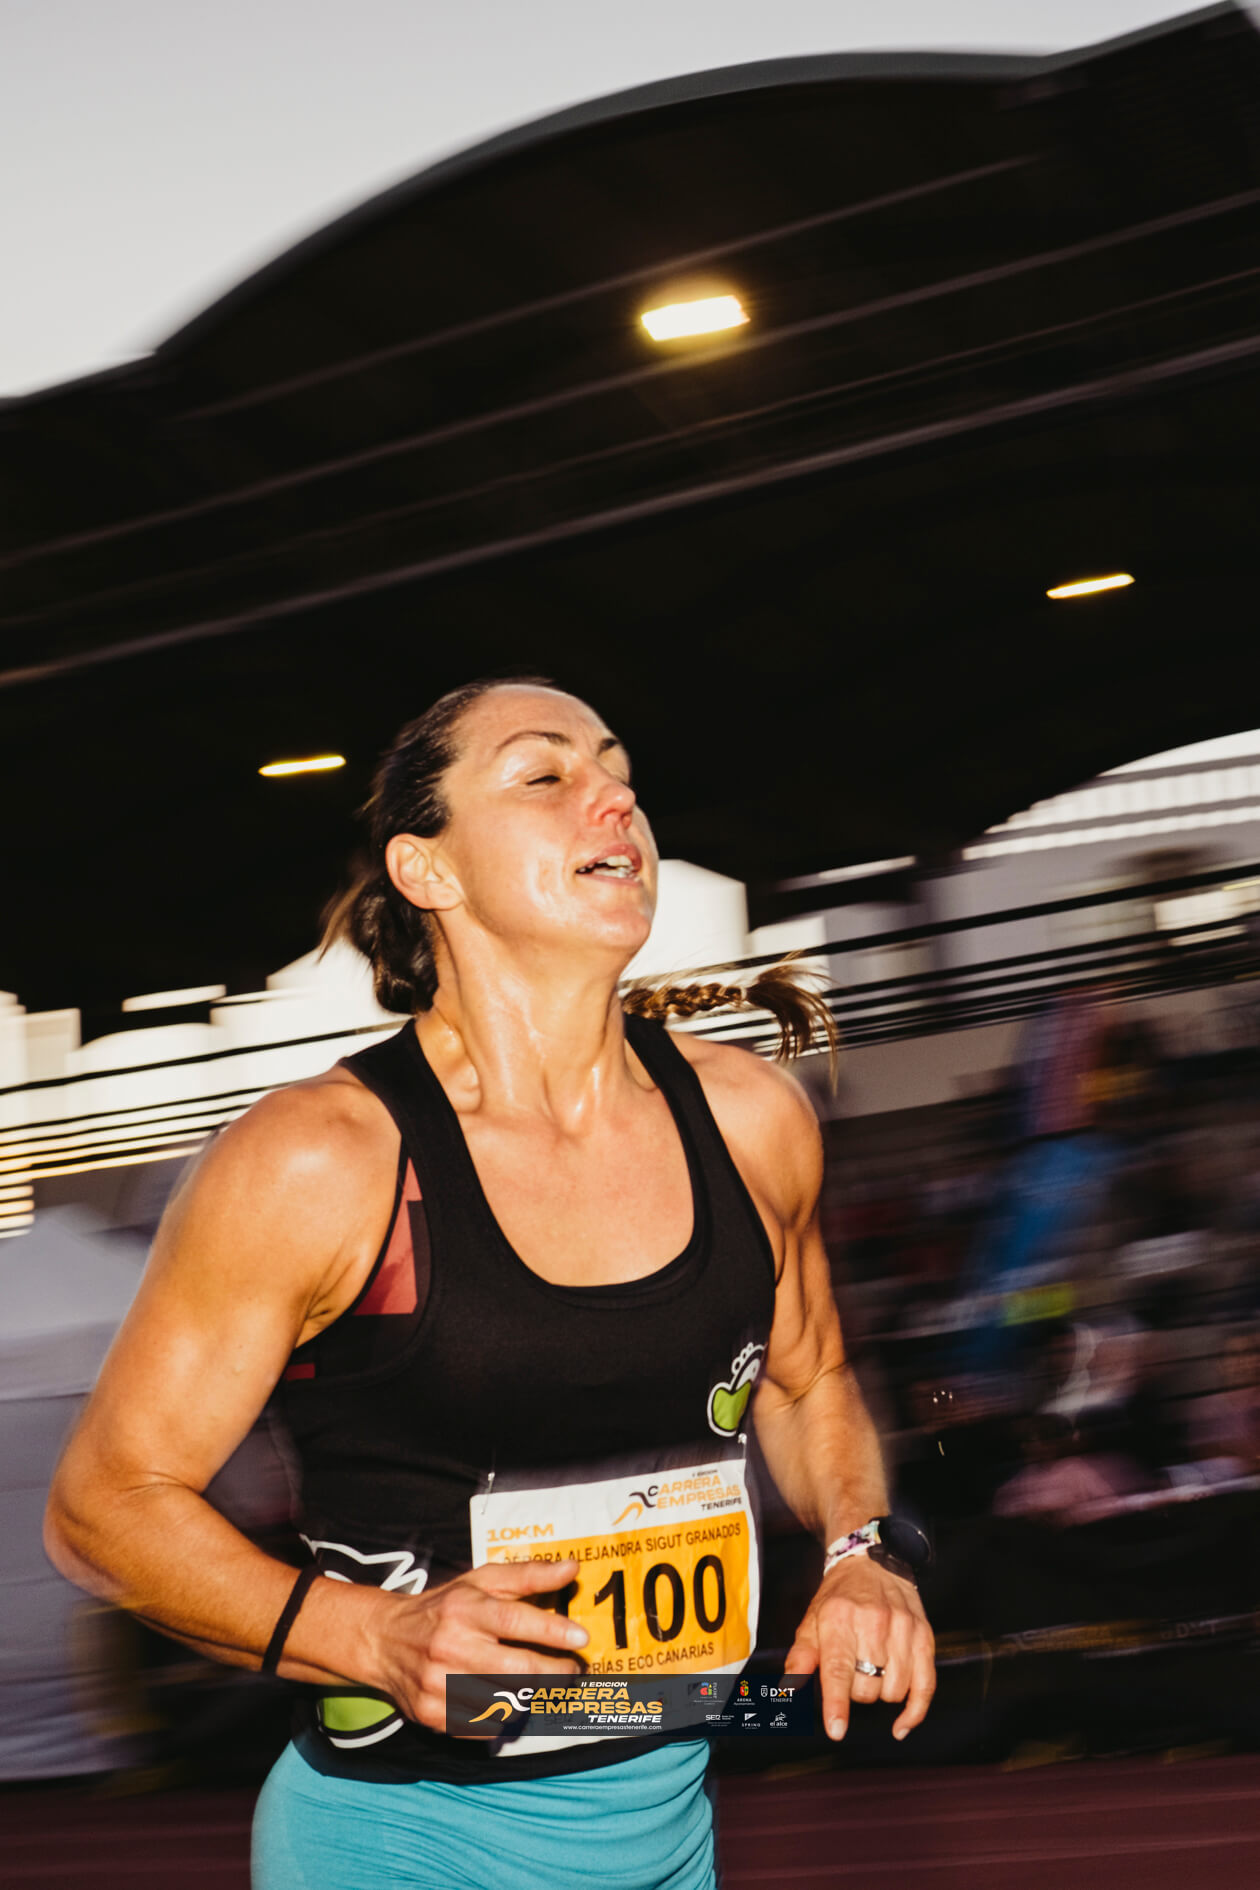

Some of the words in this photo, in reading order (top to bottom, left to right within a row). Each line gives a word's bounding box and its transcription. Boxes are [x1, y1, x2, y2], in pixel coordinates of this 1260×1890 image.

[648, 1475, 721, 1497] CARRERA
[656, 1484, 741, 1509] EMPRESAS
[700, 1497, 742, 1511] TENERIFE
[487, 1523, 554, 1542] 10KM
[568, 1543, 642, 1563] ALEJANDRA
[646, 1532, 682, 1552] SIGUT
[686, 1522, 741, 1545] GRANADOS
[628, 1653, 654, 1671] ECO
[656, 1642, 715, 1665] CANARIAS
